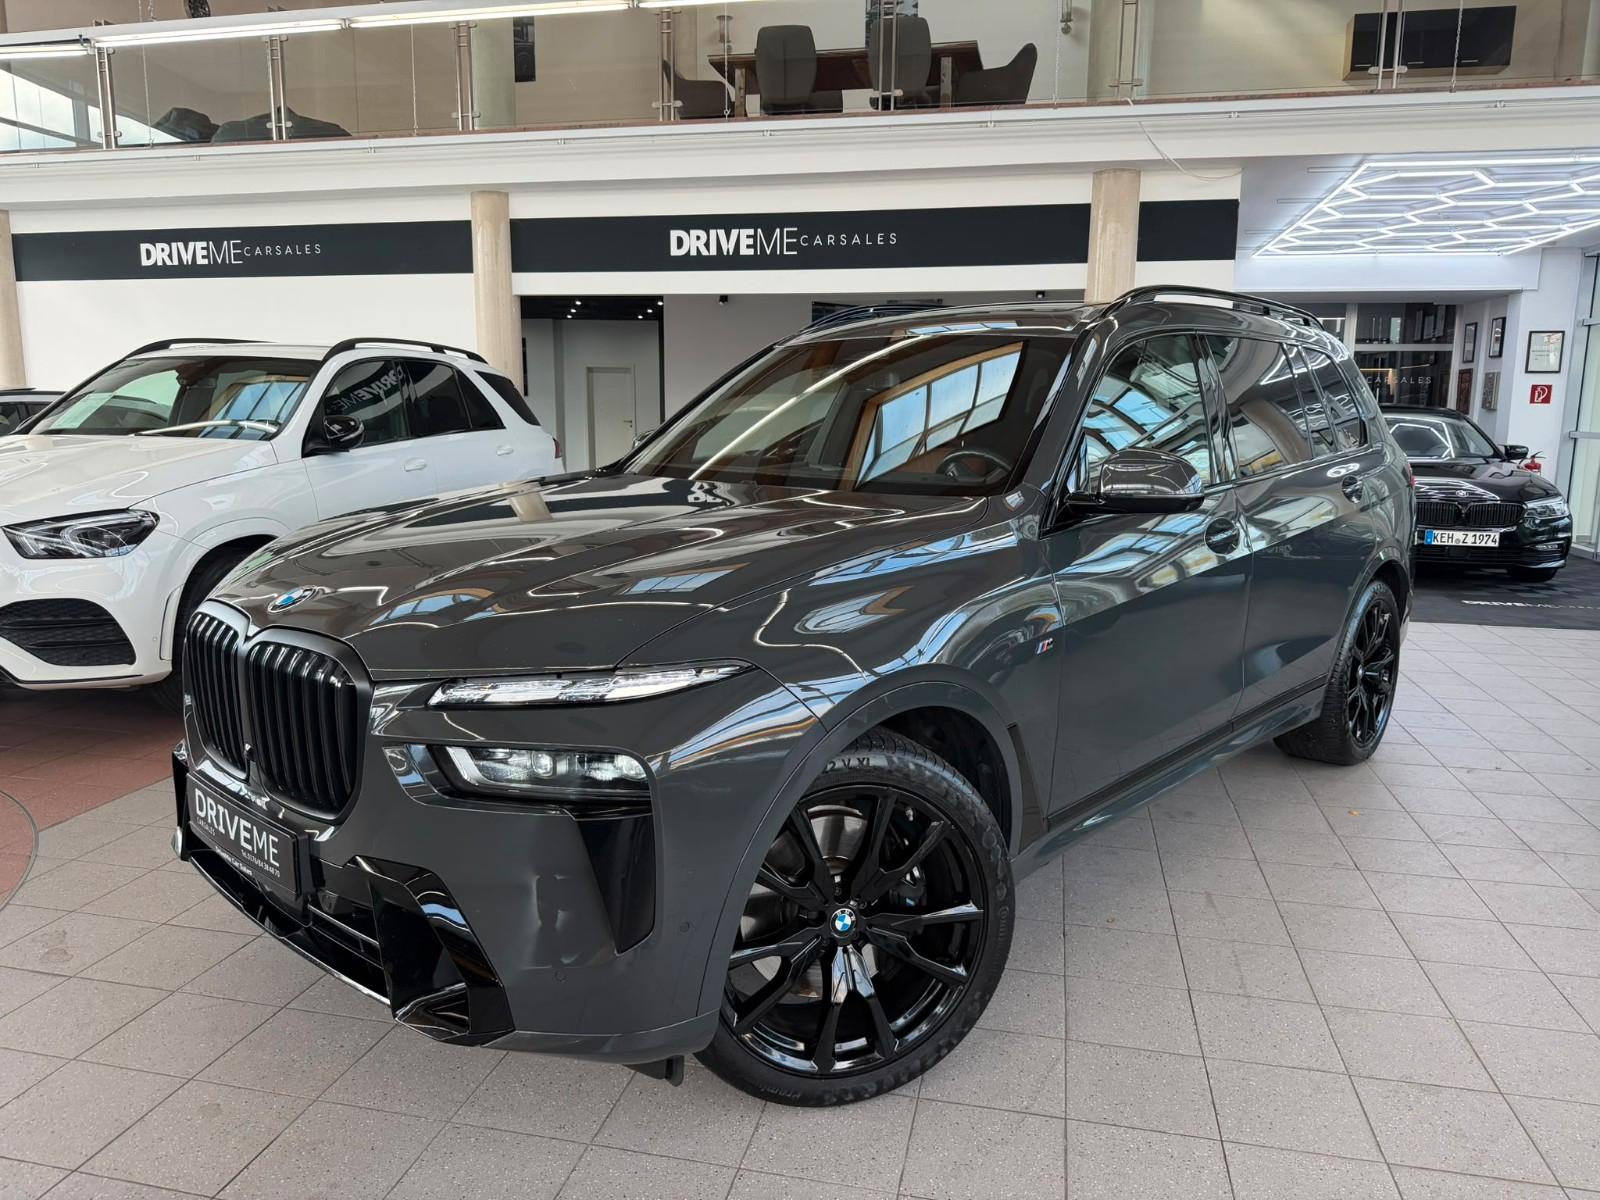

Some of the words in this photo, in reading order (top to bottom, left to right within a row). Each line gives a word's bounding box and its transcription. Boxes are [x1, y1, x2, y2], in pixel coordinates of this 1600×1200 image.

[140, 240, 243, 266] DRIVEME
[243, 243, 321, 257] CARSALES
[670, 227, 798, 256] DRIVEME
[800, 232, 897, 247] CARSALES
[1433, 532, 1454, 544] KEH
[1461, 533, 1469, 544] Z
[1471, 533, 1498, 545] 1974
[195, 788, 280, 867] DRIVEME
